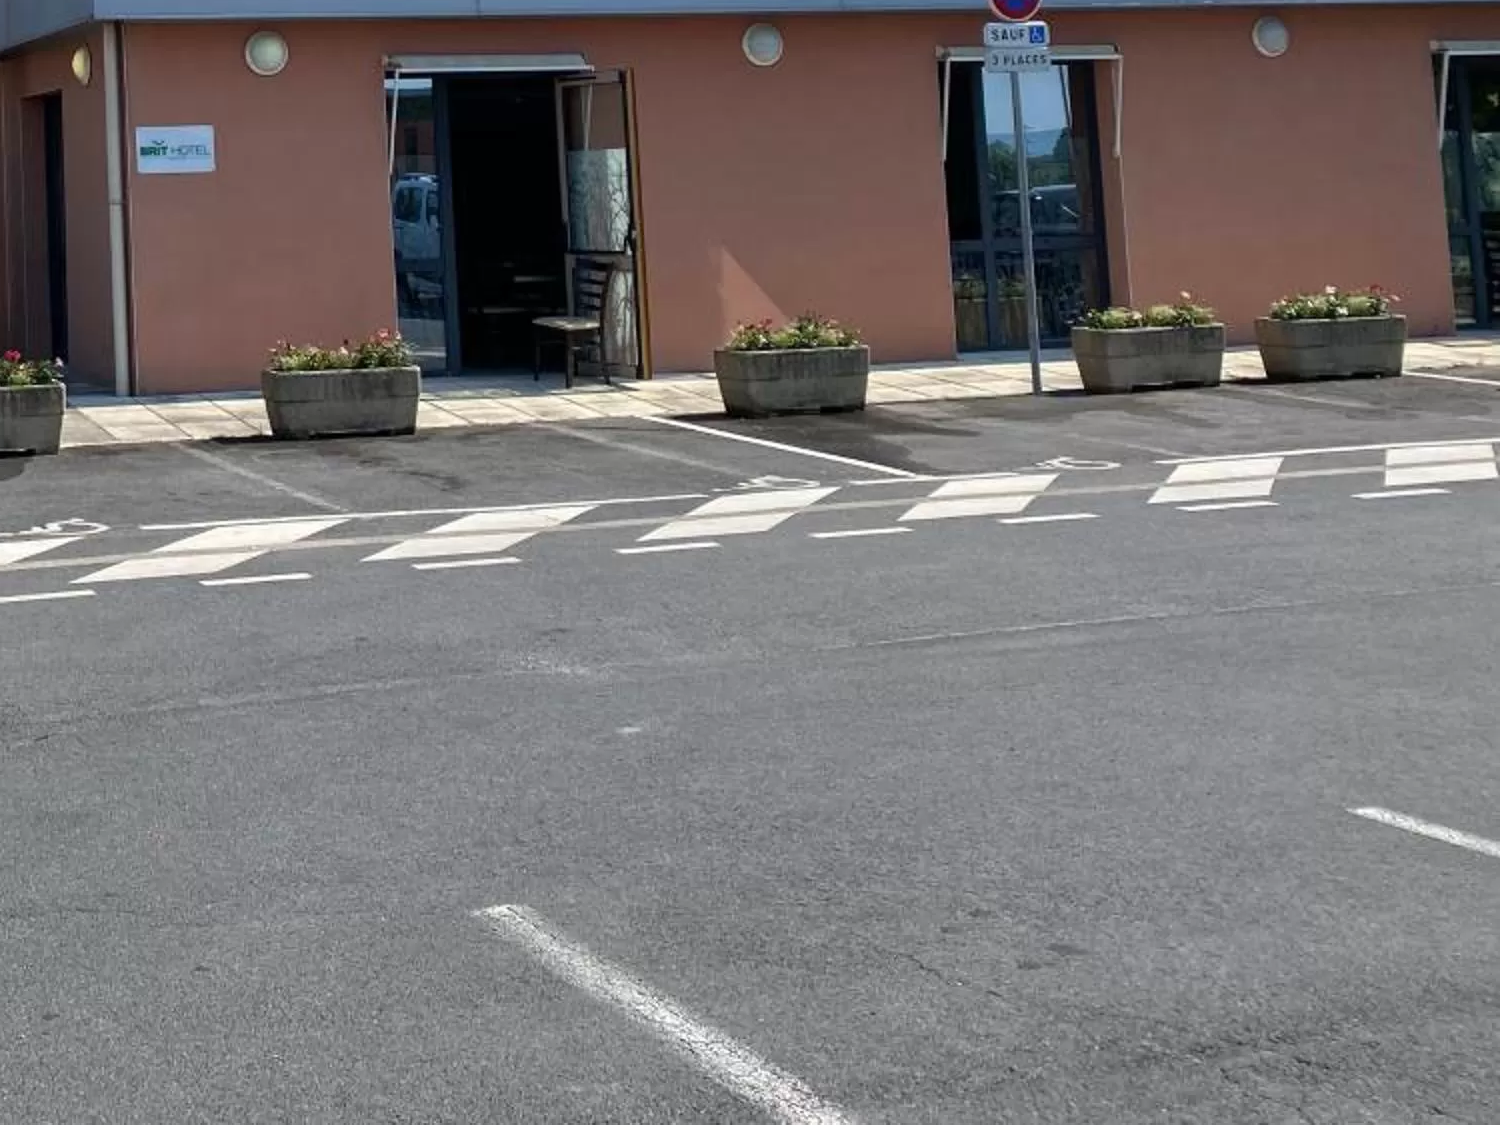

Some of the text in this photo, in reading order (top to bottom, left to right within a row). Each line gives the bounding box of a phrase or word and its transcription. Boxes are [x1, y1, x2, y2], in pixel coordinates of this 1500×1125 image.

[990, 28, 1027, 42] SAUF
[991, 53, 1048, 66] 3 PLACES
[140, 145, 212, 157] BRIT HOTEL
